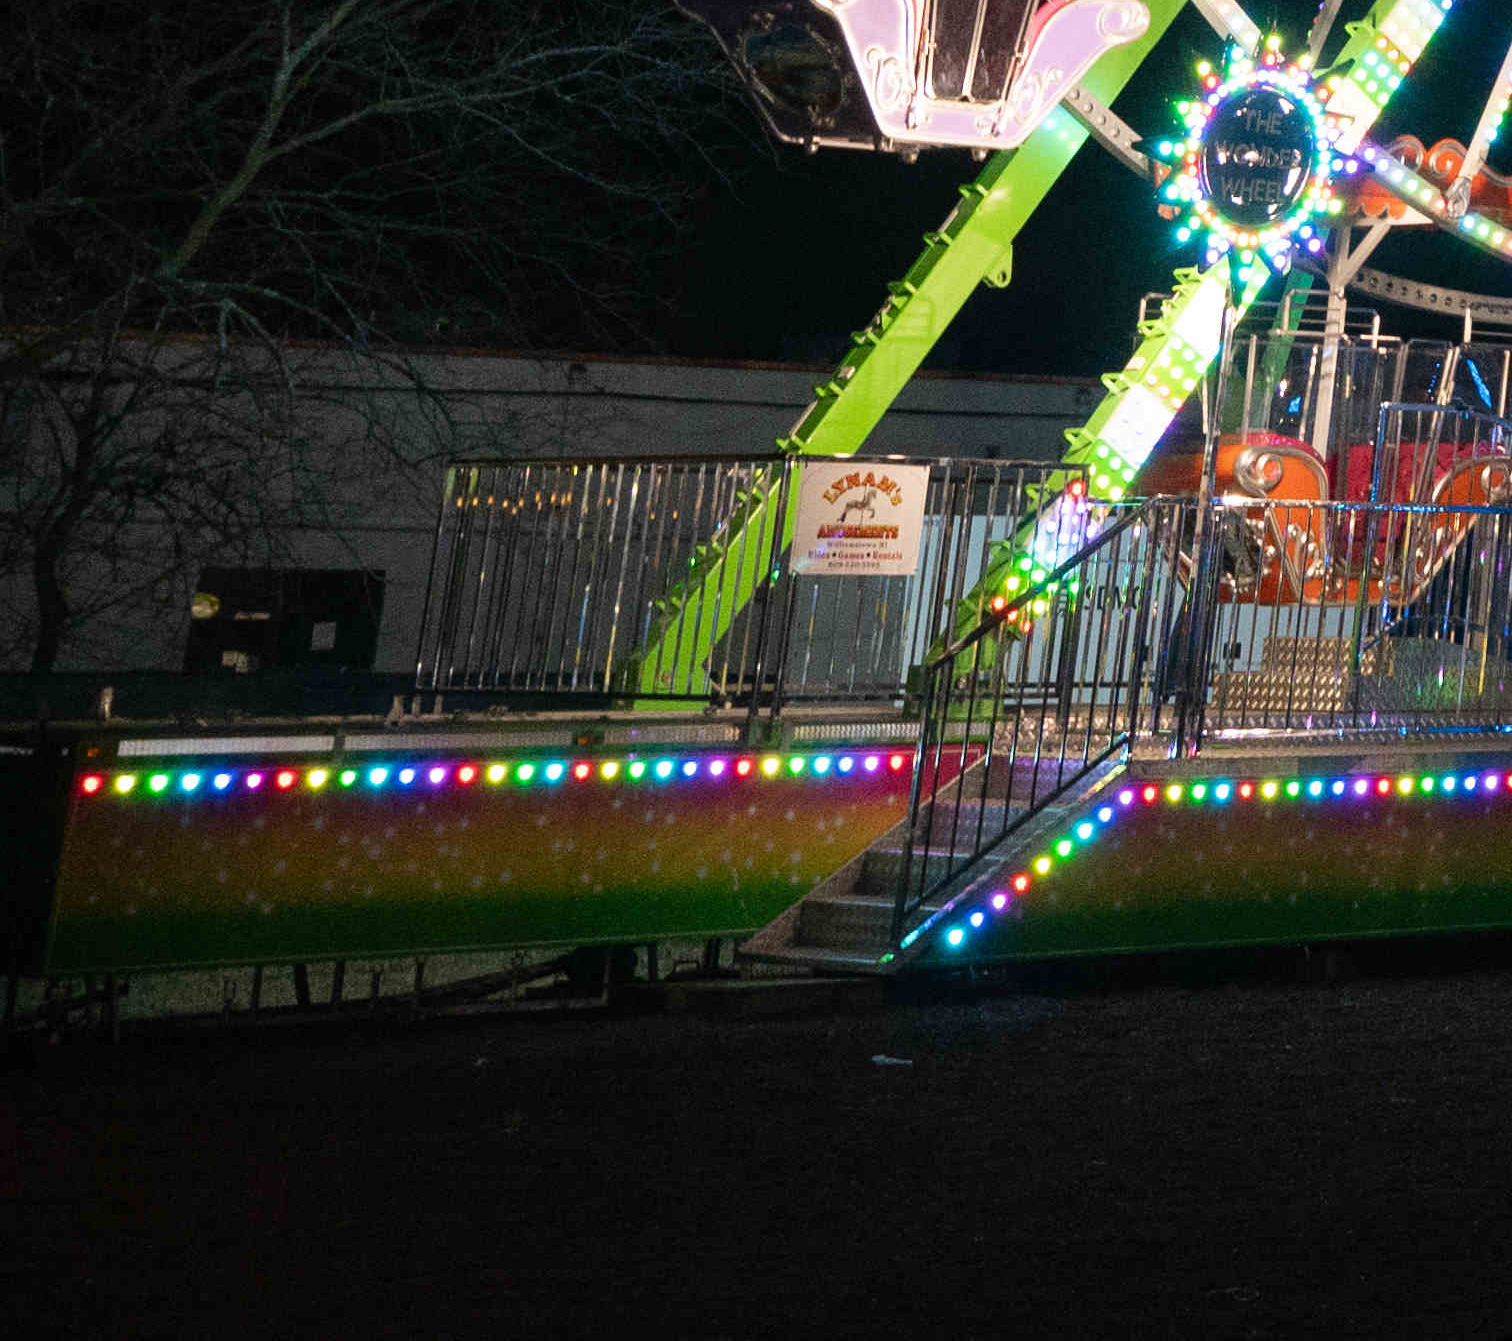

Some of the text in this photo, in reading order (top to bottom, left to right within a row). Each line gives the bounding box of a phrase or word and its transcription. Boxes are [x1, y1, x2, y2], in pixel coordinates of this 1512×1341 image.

[1244, 108, 1282, 135] THE
[823, 471, 903, 507] LYNAM'S
[838, 551, 865, 560] Games
[872, 550, 903, 560] Rentals
